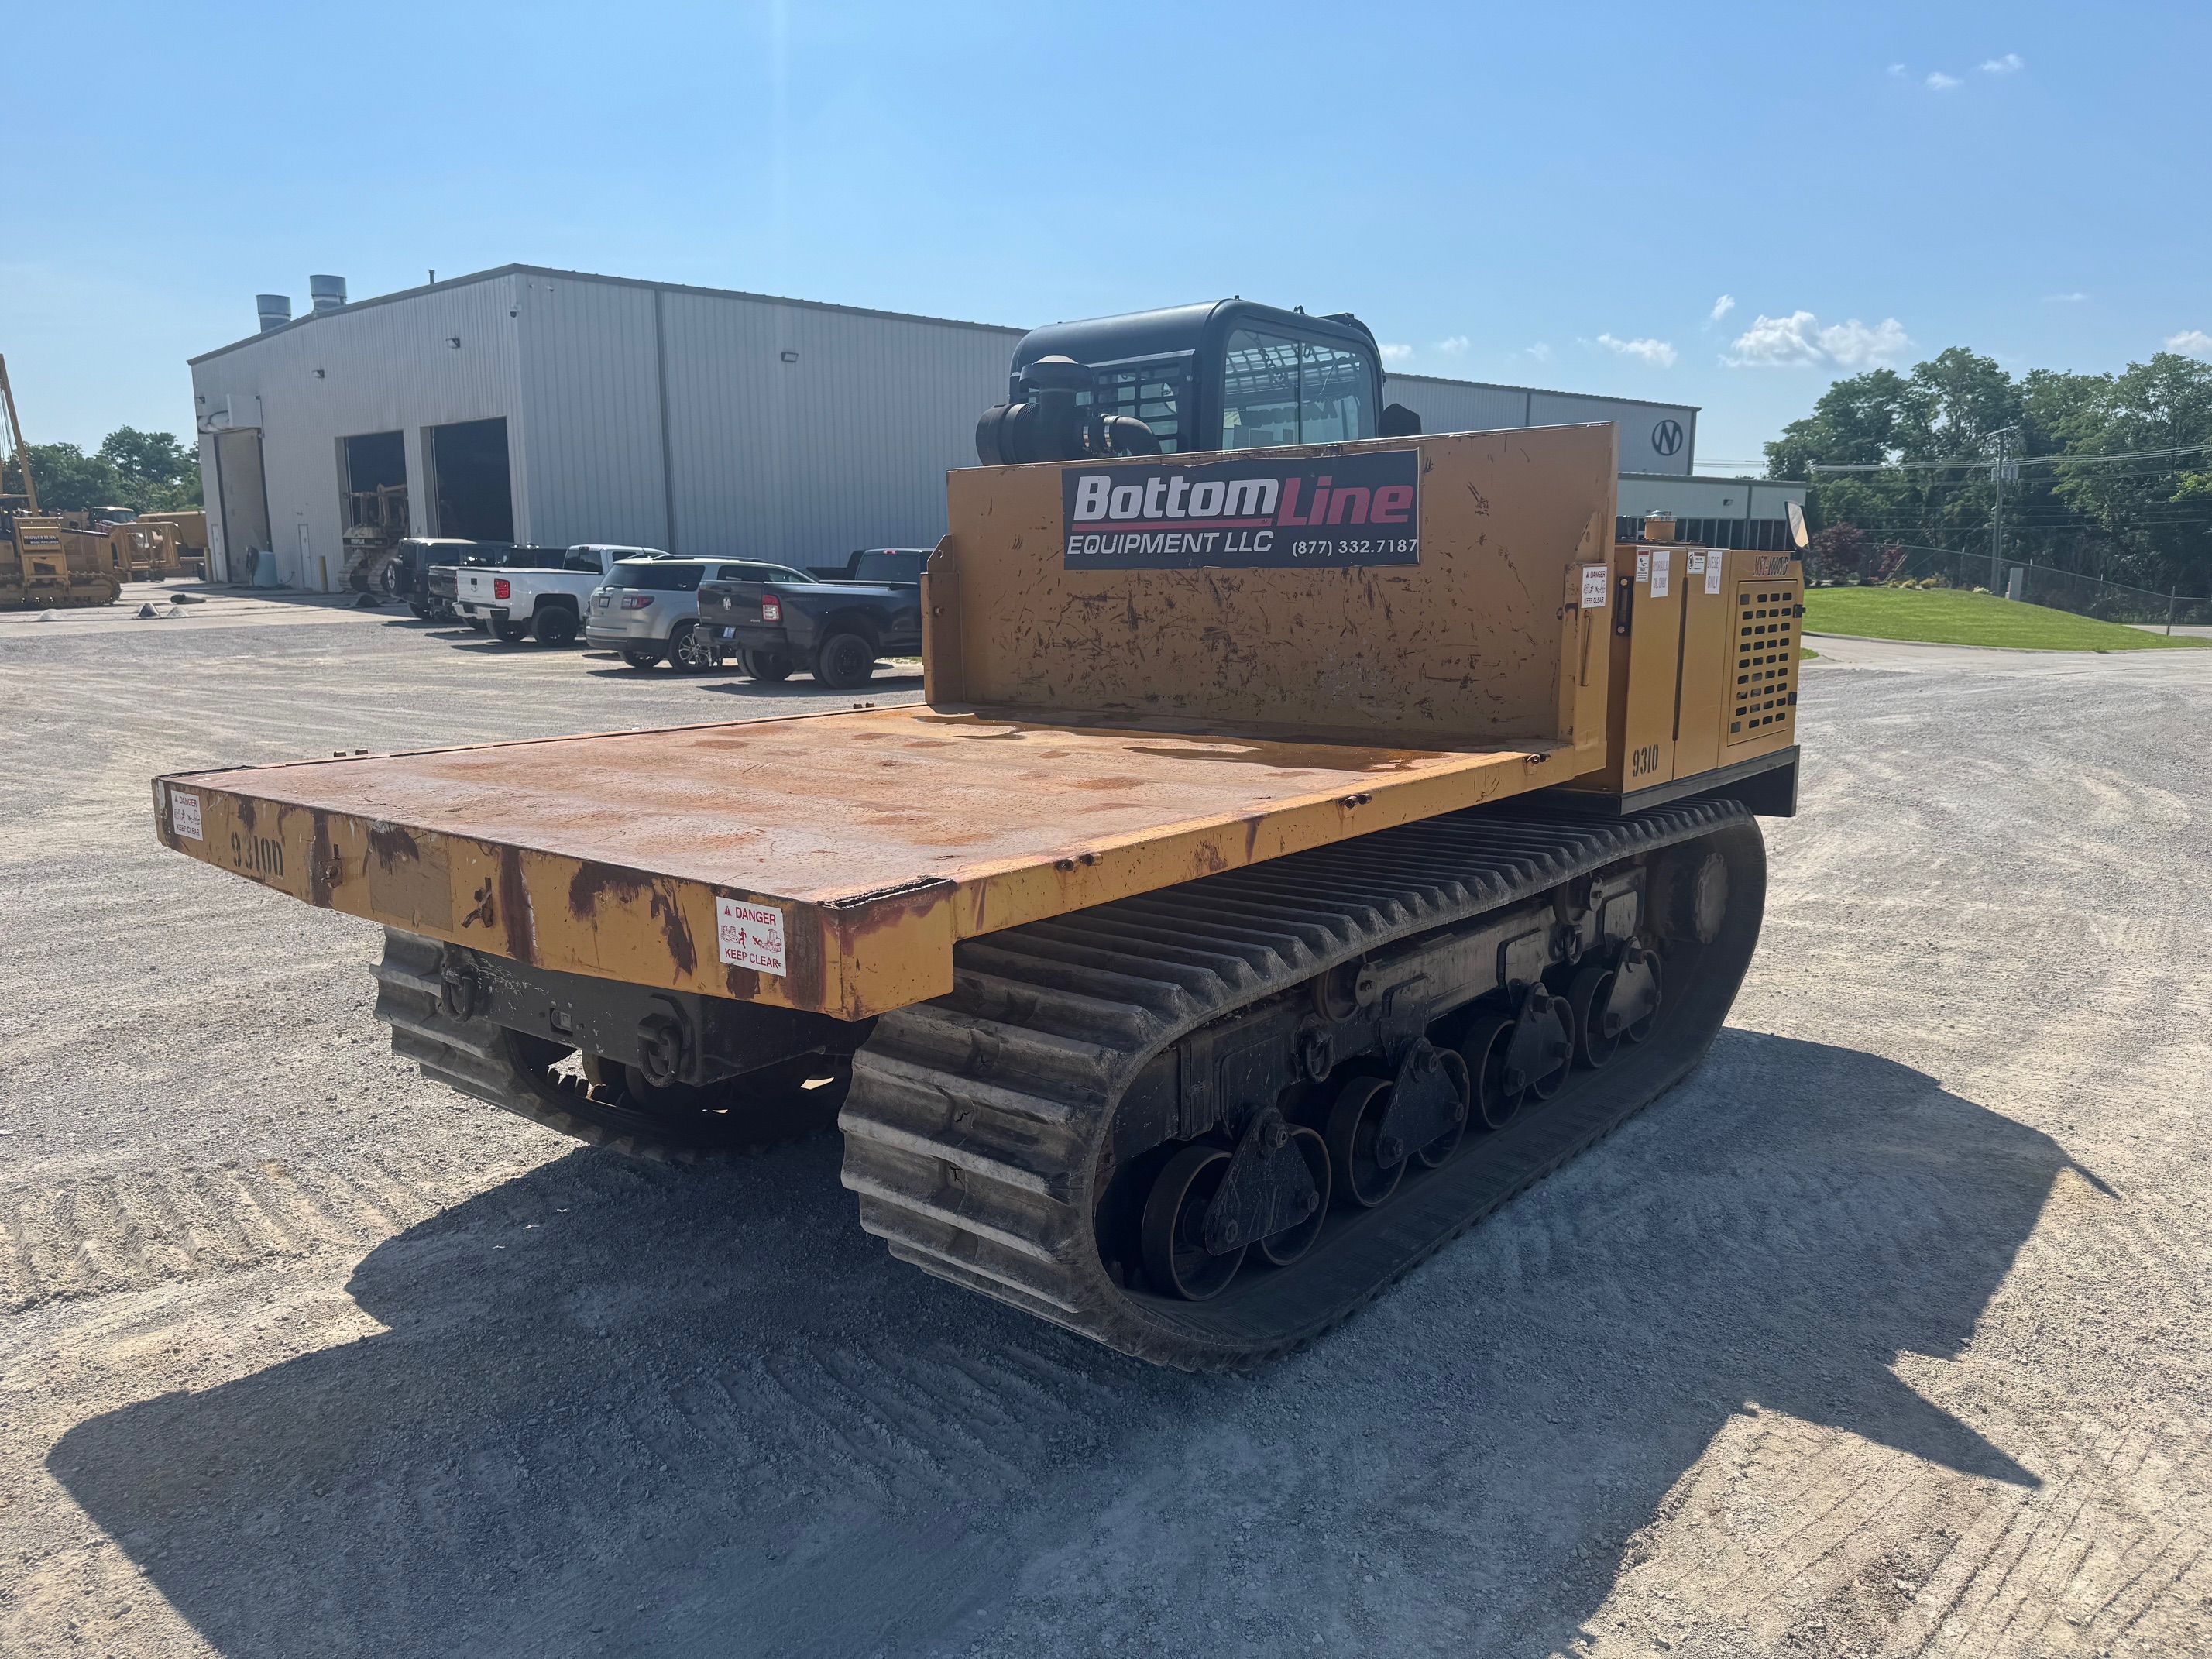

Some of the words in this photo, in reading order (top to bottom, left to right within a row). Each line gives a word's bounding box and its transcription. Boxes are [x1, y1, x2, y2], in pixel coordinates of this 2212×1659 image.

[1066, 532, 1220, 555] EQUIPMENT
[1224, 531, 1275, 552] LLC
[1292, 541, 1333, 558] (877)
[1338, 538, 1417, 555] 332.7187
[1590, 570, 1606, 579] DANGER
[1633, 744, 1659, 777] 9310
[179, 795, 198, 808] DANGER
[177, 823, 187, 832] KEEP
[187, 826, 201, 836] CLEAR
[735, 906, 776, 926] DANGER
[725, 947, 747, 960] KEEP
[749, 953, 779, 969] CLEAR
